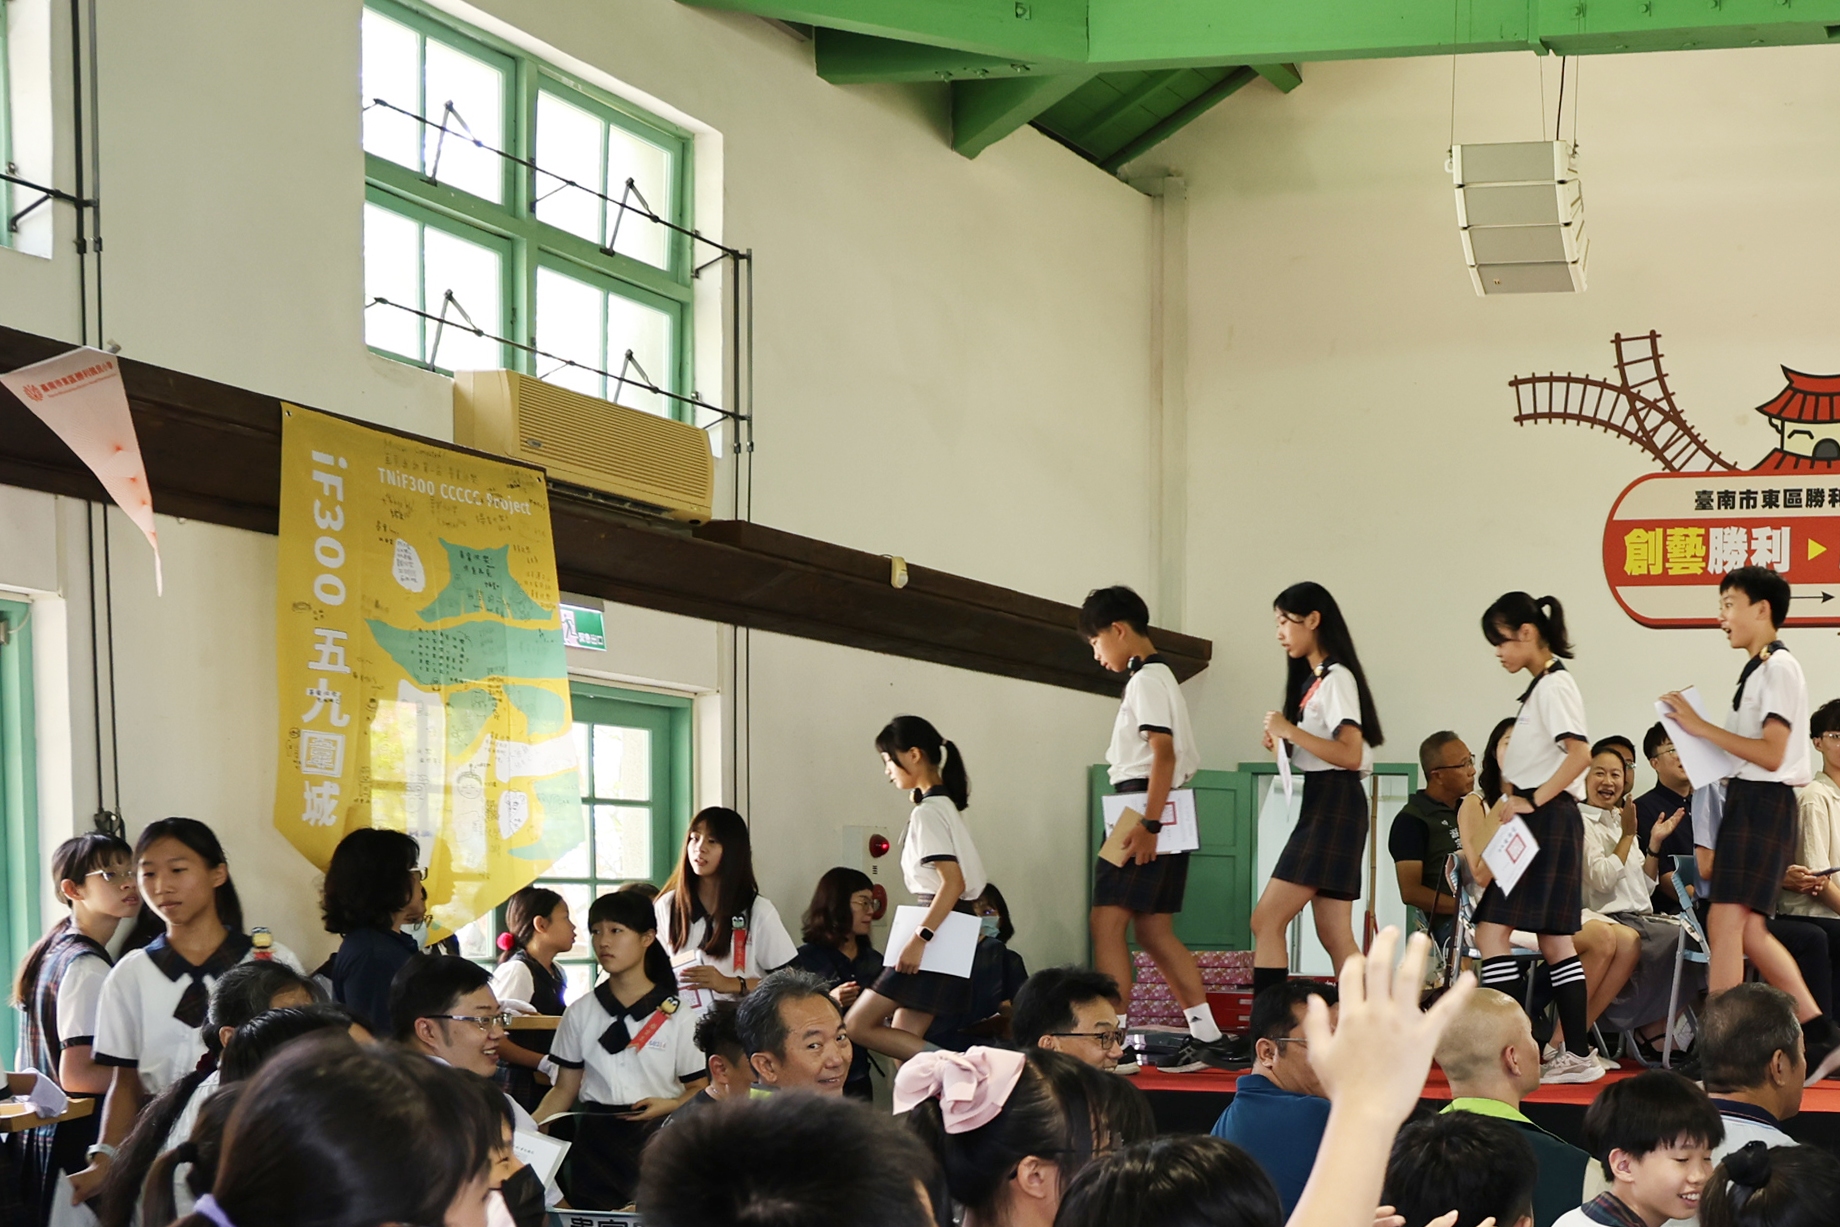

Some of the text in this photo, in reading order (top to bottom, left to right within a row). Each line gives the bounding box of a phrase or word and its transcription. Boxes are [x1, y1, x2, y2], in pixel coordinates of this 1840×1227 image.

[377, 466, 435, 497] TNiF300
[311, 449, 348, 606] iF300
[1623, 525, 1791, 576] 創藝勝利
